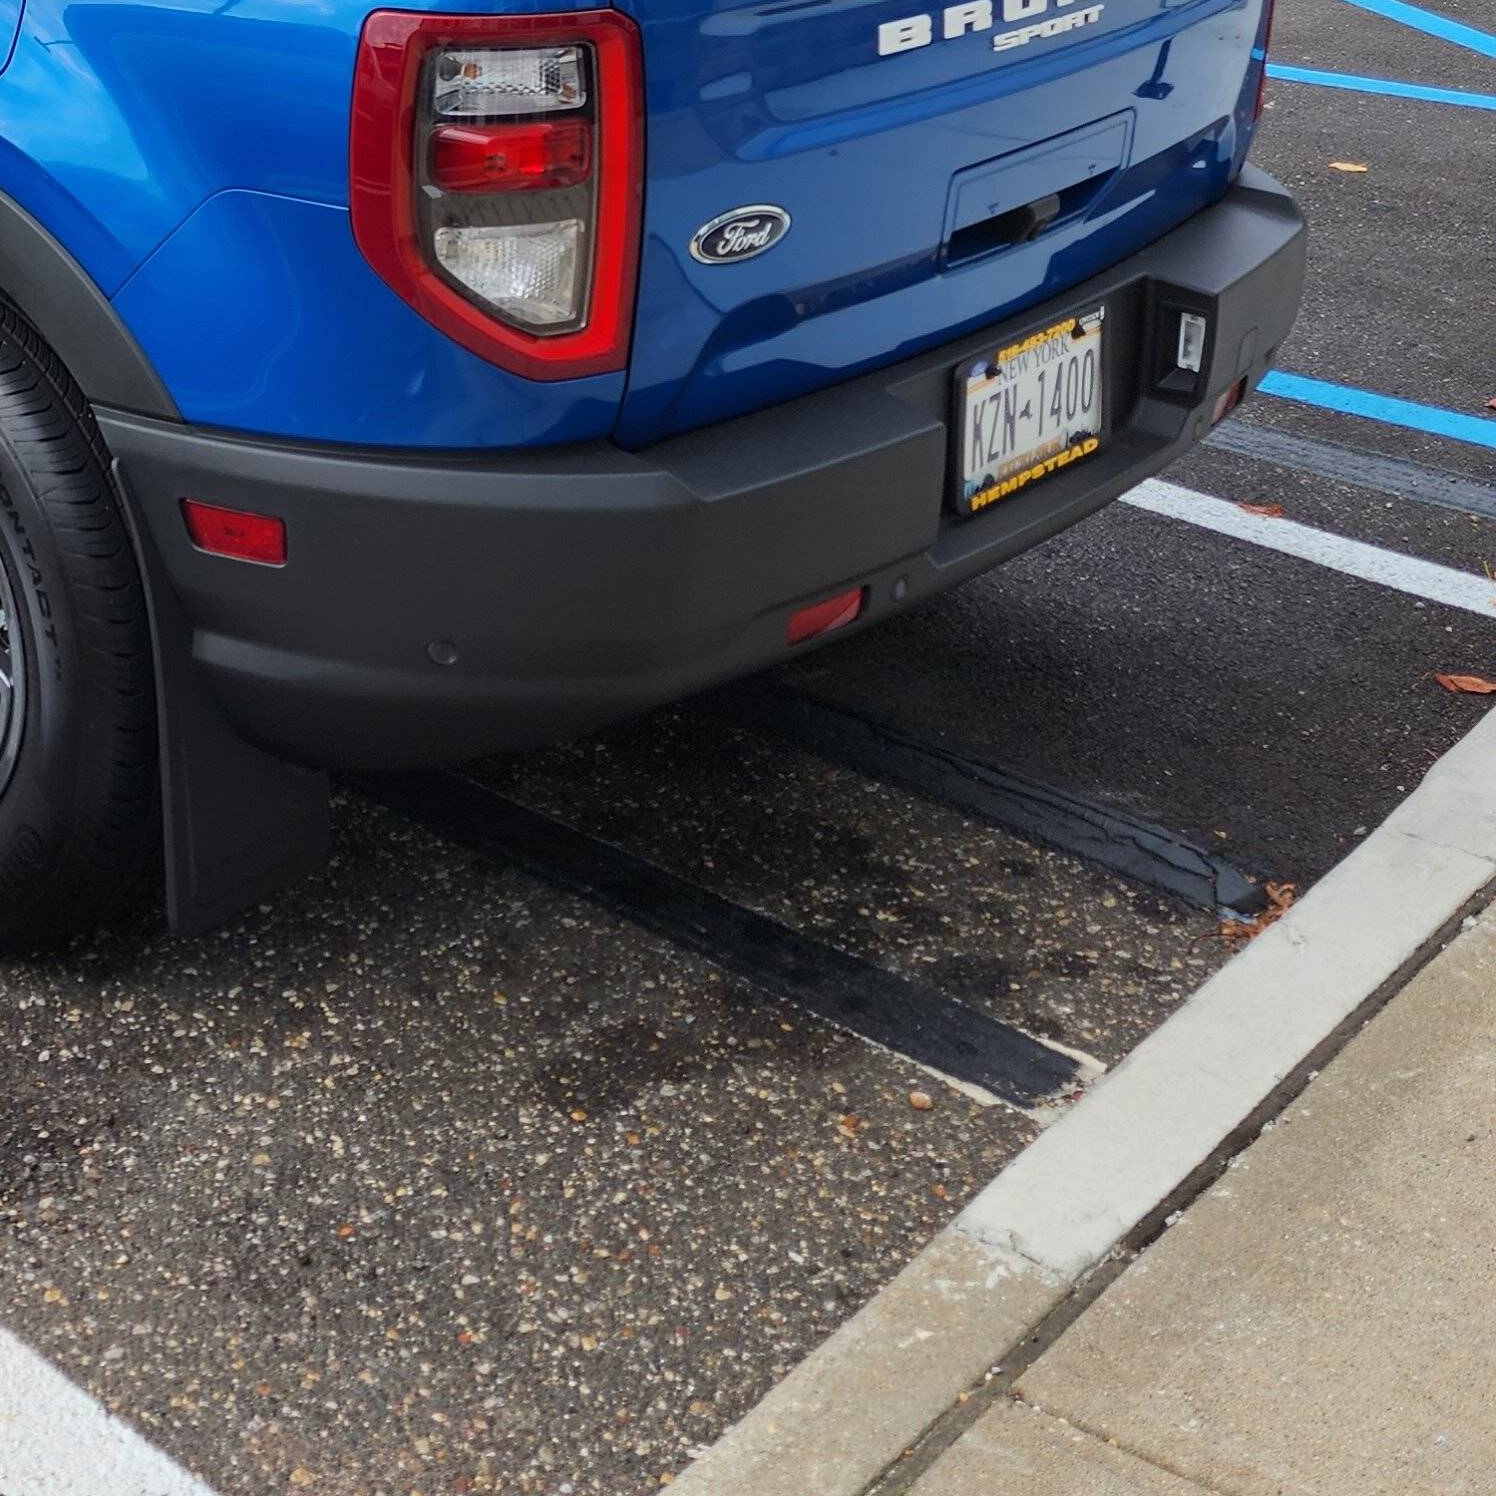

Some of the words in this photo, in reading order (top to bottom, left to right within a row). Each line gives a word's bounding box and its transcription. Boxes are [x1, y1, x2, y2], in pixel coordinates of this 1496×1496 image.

[993, 4, 1104, 52] SPORT
[716, 218, 773, 255] Ford
[999, 354, 1031, 386] NEW
[1033, 333, 1070, 368] YORK
[970, 438, 1099, 512] HEMPSTEAD
